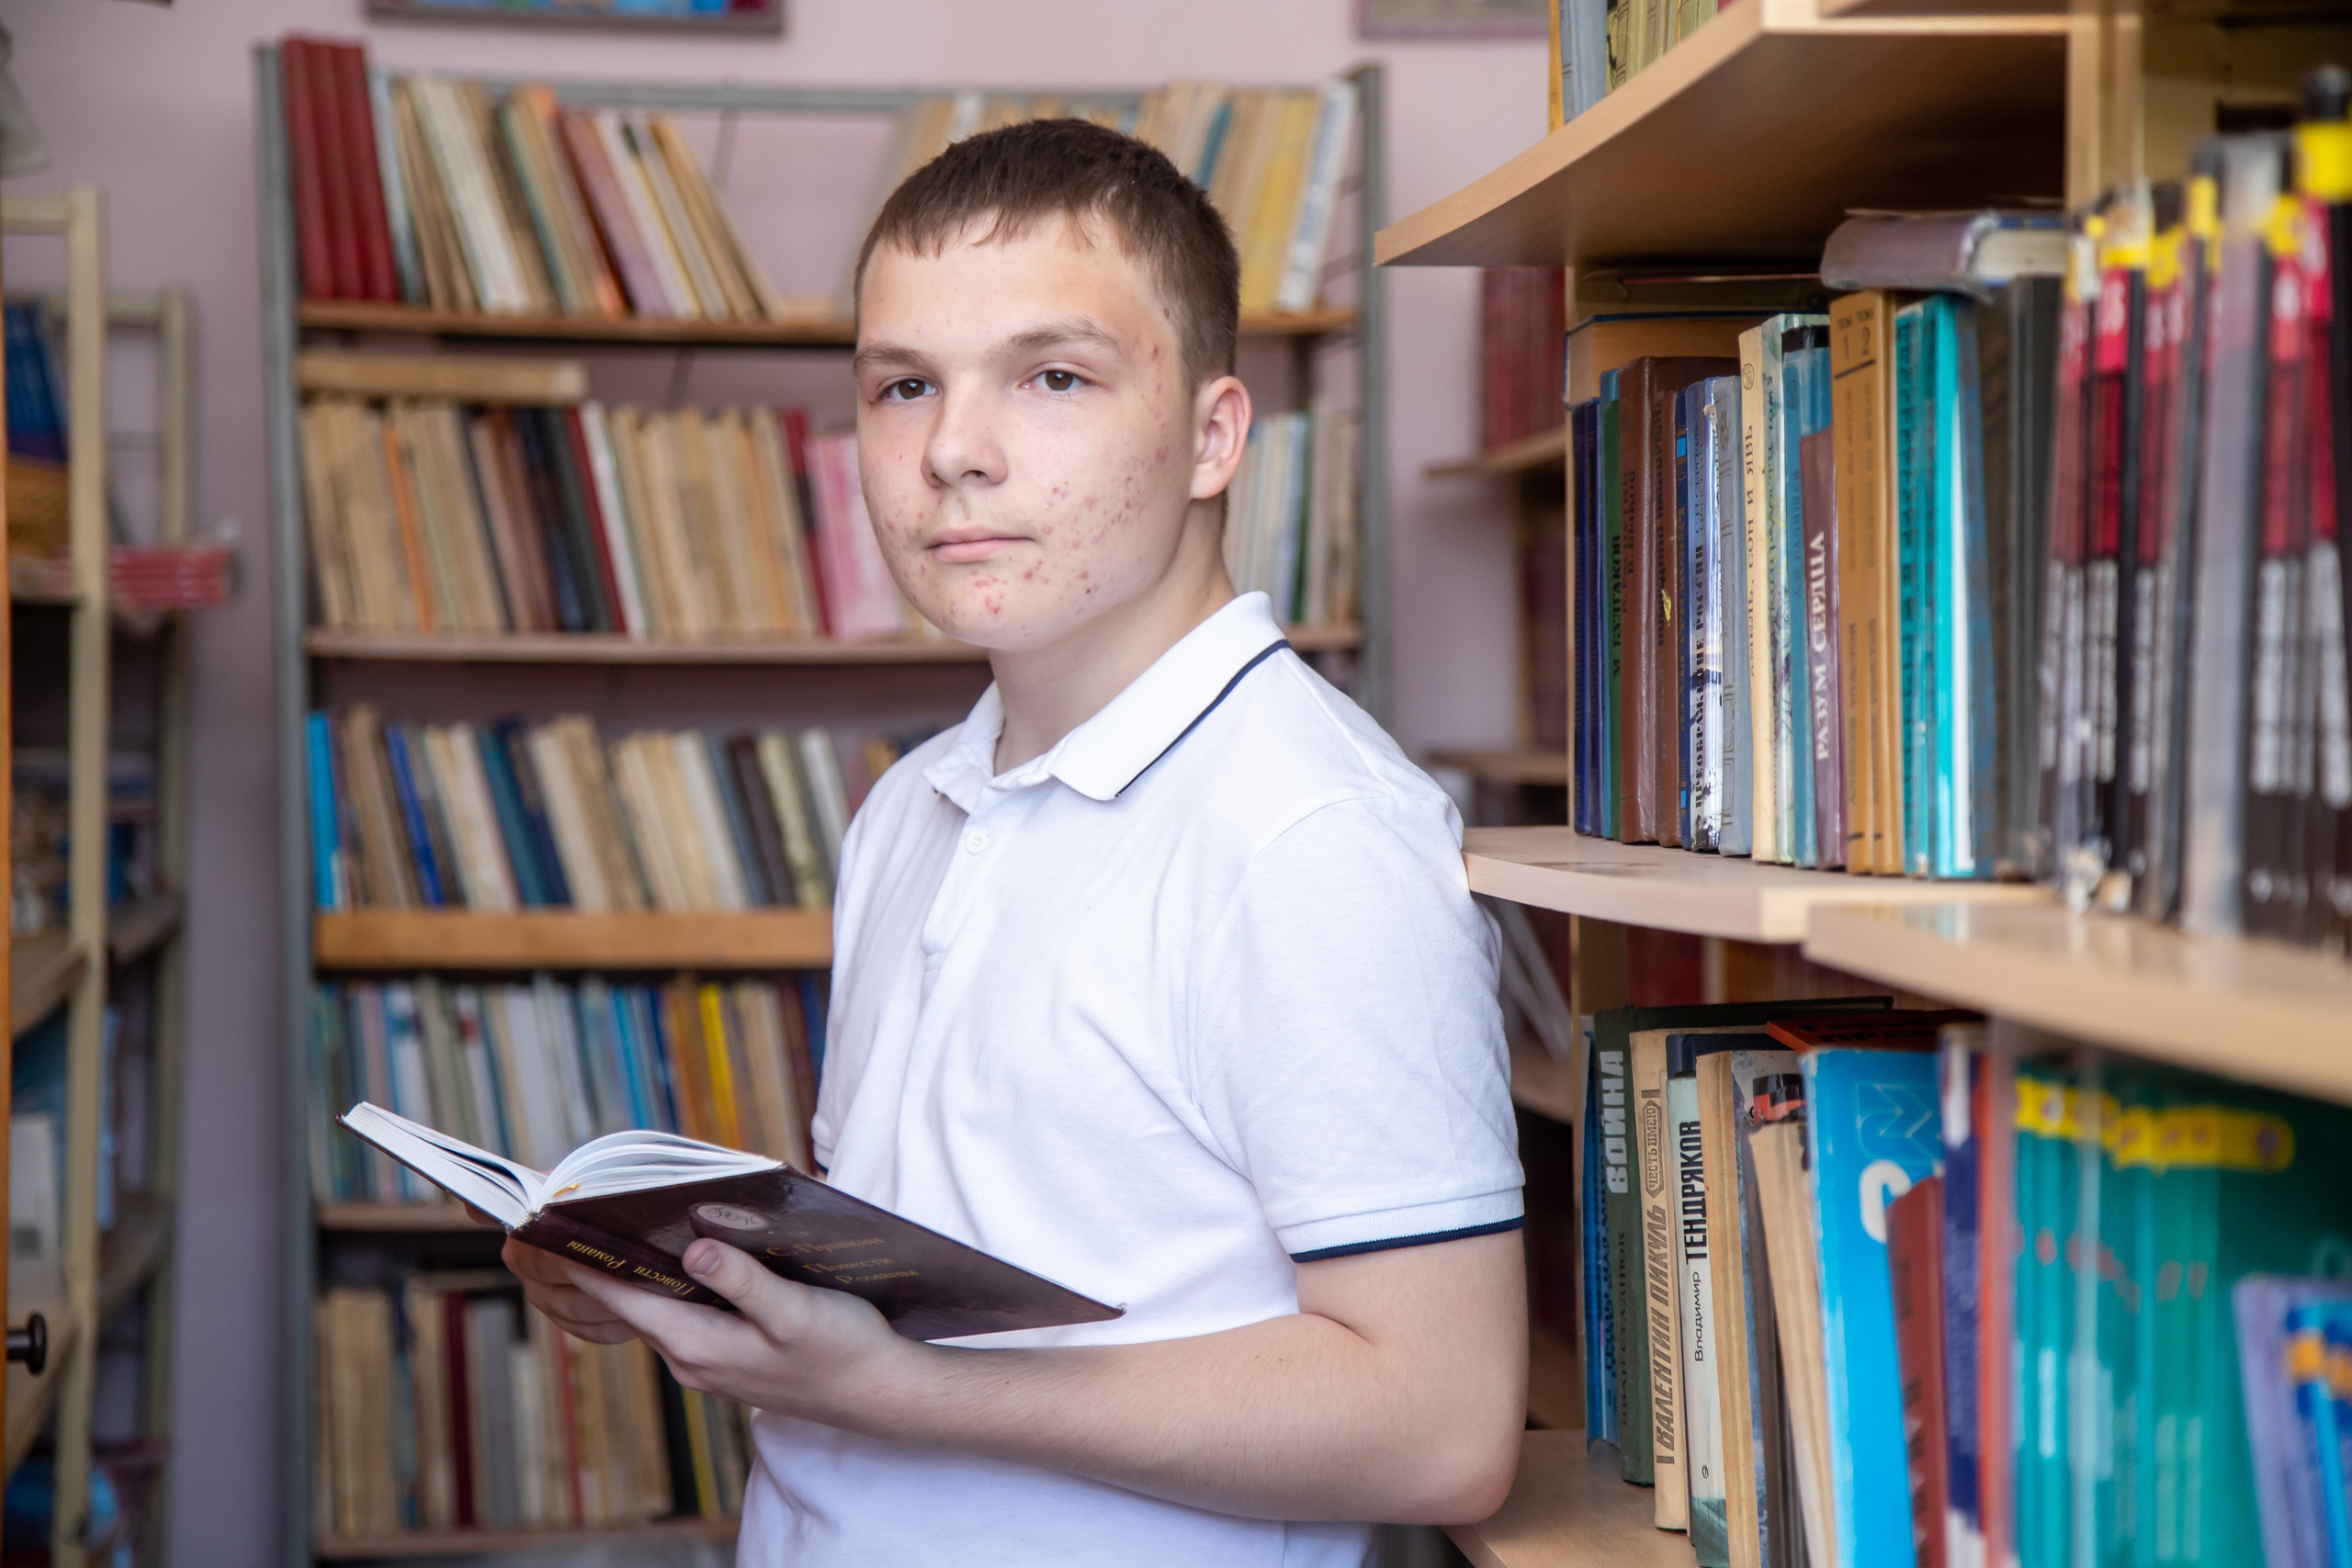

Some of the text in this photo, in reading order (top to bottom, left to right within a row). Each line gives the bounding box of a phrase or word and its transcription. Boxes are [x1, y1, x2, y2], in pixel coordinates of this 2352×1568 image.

[1745, 424, 1754, 477] ЯВЬ
[1747, 490, 1754, 505] И
[1746, 519, 1755, 568] СОН
[1611, 535, 1621, 647] БУЛГАКОВ
[1695, 543, 1705, 810] ПРЕОБРАЖЕНИЕ РОССИИ
[1808, 531, 1829, 761] РАЗУМ СЕРДЦА
[1599, 1050, 1628, 1193] ВОЙНА
[1646, 1106, 1659, 1190] ЧЕСТЬ ИМЕЮ
[566, 1240, 695, 1296] Повести Романы
[802, 1258, 895, 1273] Повести
[835, 1269, 920, 1284] Романы
[1679, 1120, 1708, 1362] Владимир ТЕНДРЯКОВ
[1645, 1204, 1675, 1451] ВАЛЕНТИН ПИКУЛЬ
